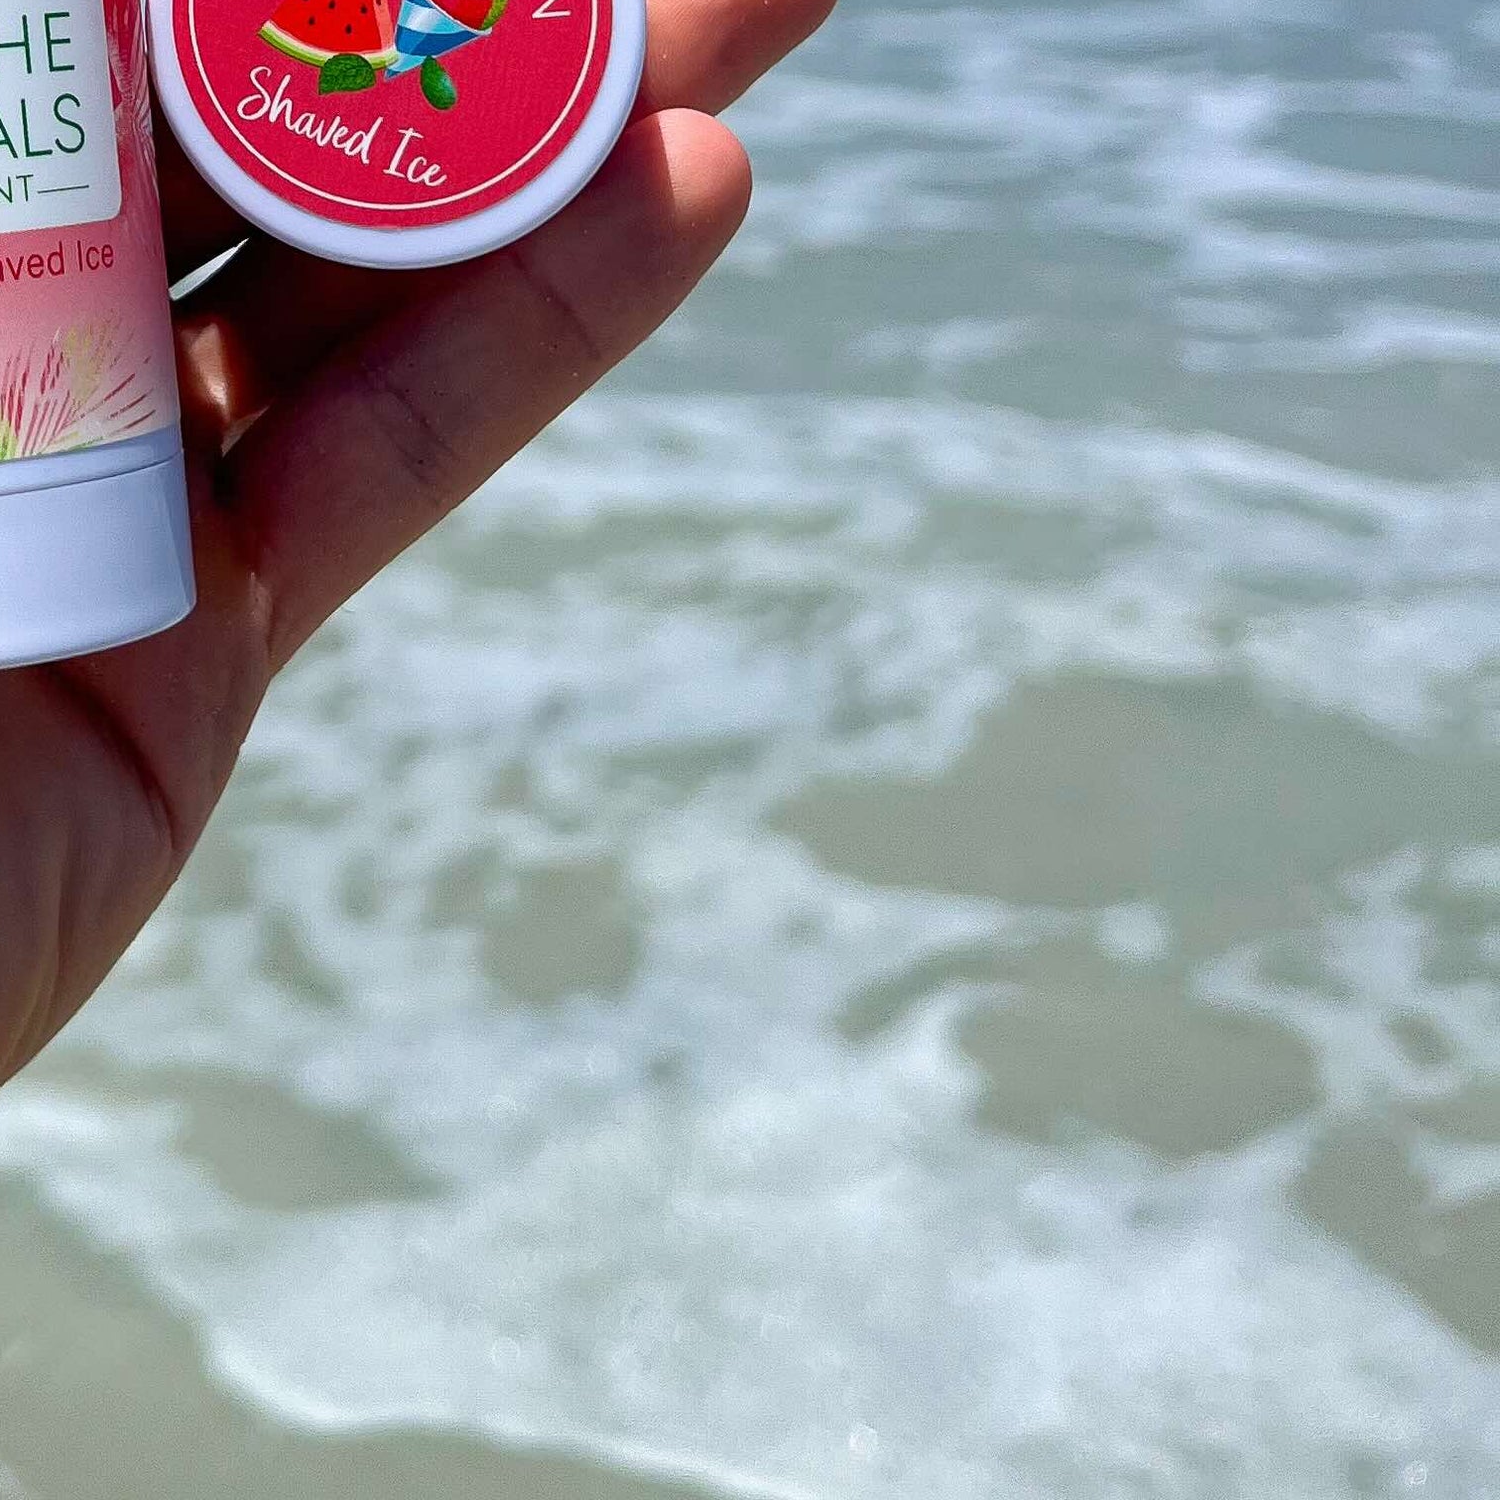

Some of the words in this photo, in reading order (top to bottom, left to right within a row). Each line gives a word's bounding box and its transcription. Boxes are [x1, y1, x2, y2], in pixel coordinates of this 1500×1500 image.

[236, 64, 384, 165] Shaved
[382, 126, 448, 188] Ice
[76, 240, 116, 272] Ice
